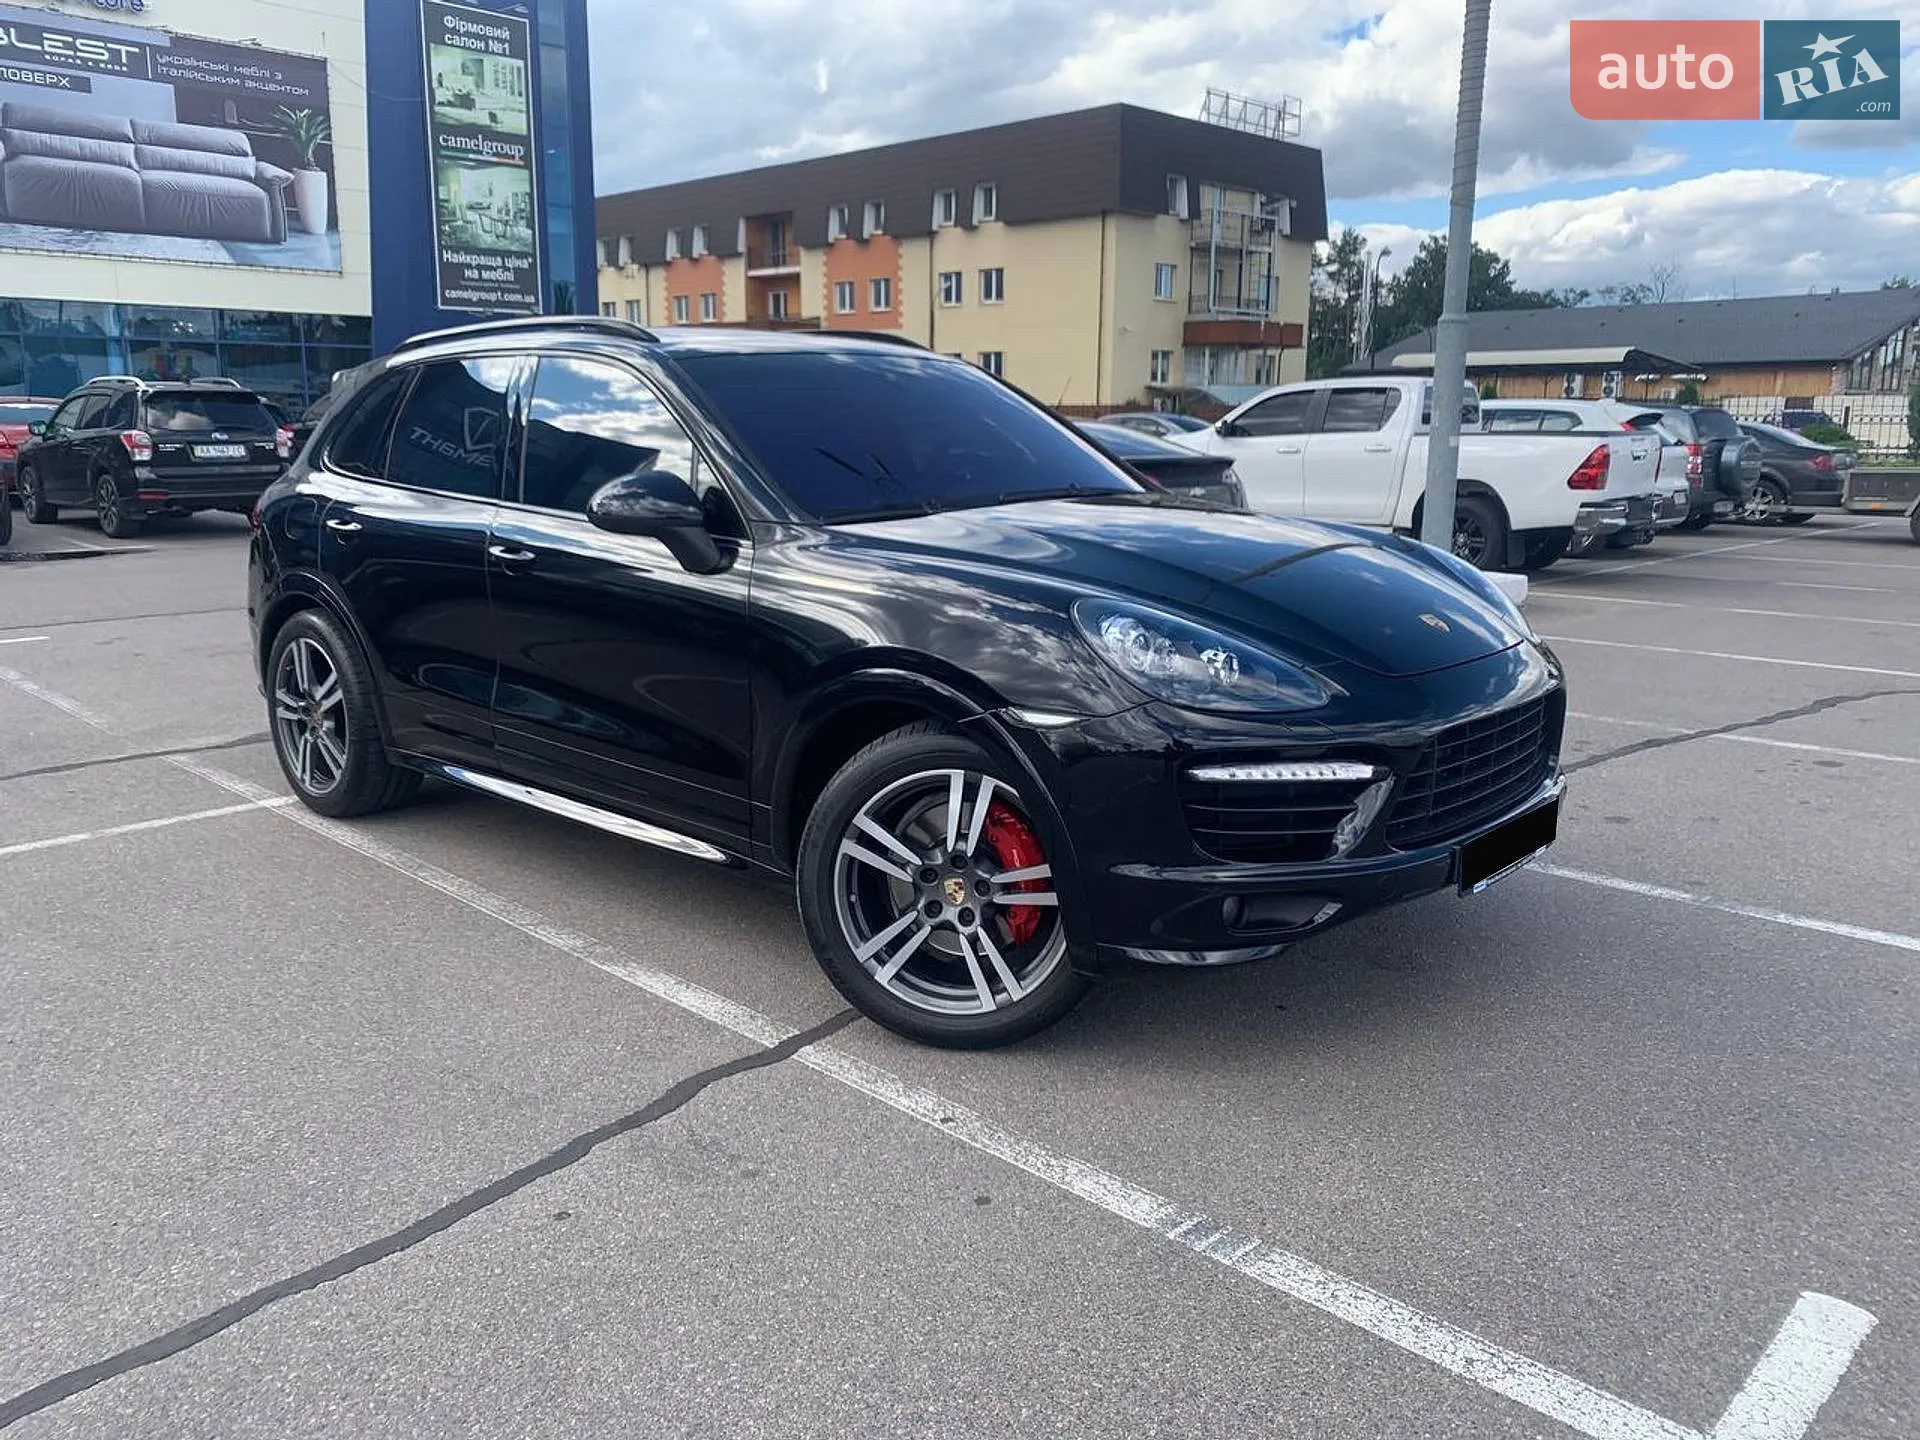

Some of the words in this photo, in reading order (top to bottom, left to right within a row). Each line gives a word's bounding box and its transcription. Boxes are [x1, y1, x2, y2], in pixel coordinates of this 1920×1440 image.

[443, 15, 510, 40] Фірмовий
[444, 33, 486, 51] салон
[488, 38, 510, 56] №1
[439, 133, 524, 160] camelgroup
[442, 249, 502, 267] Найкраща
[464, 268, 479, 279] на
[481, 268, 515, 281] меблі
